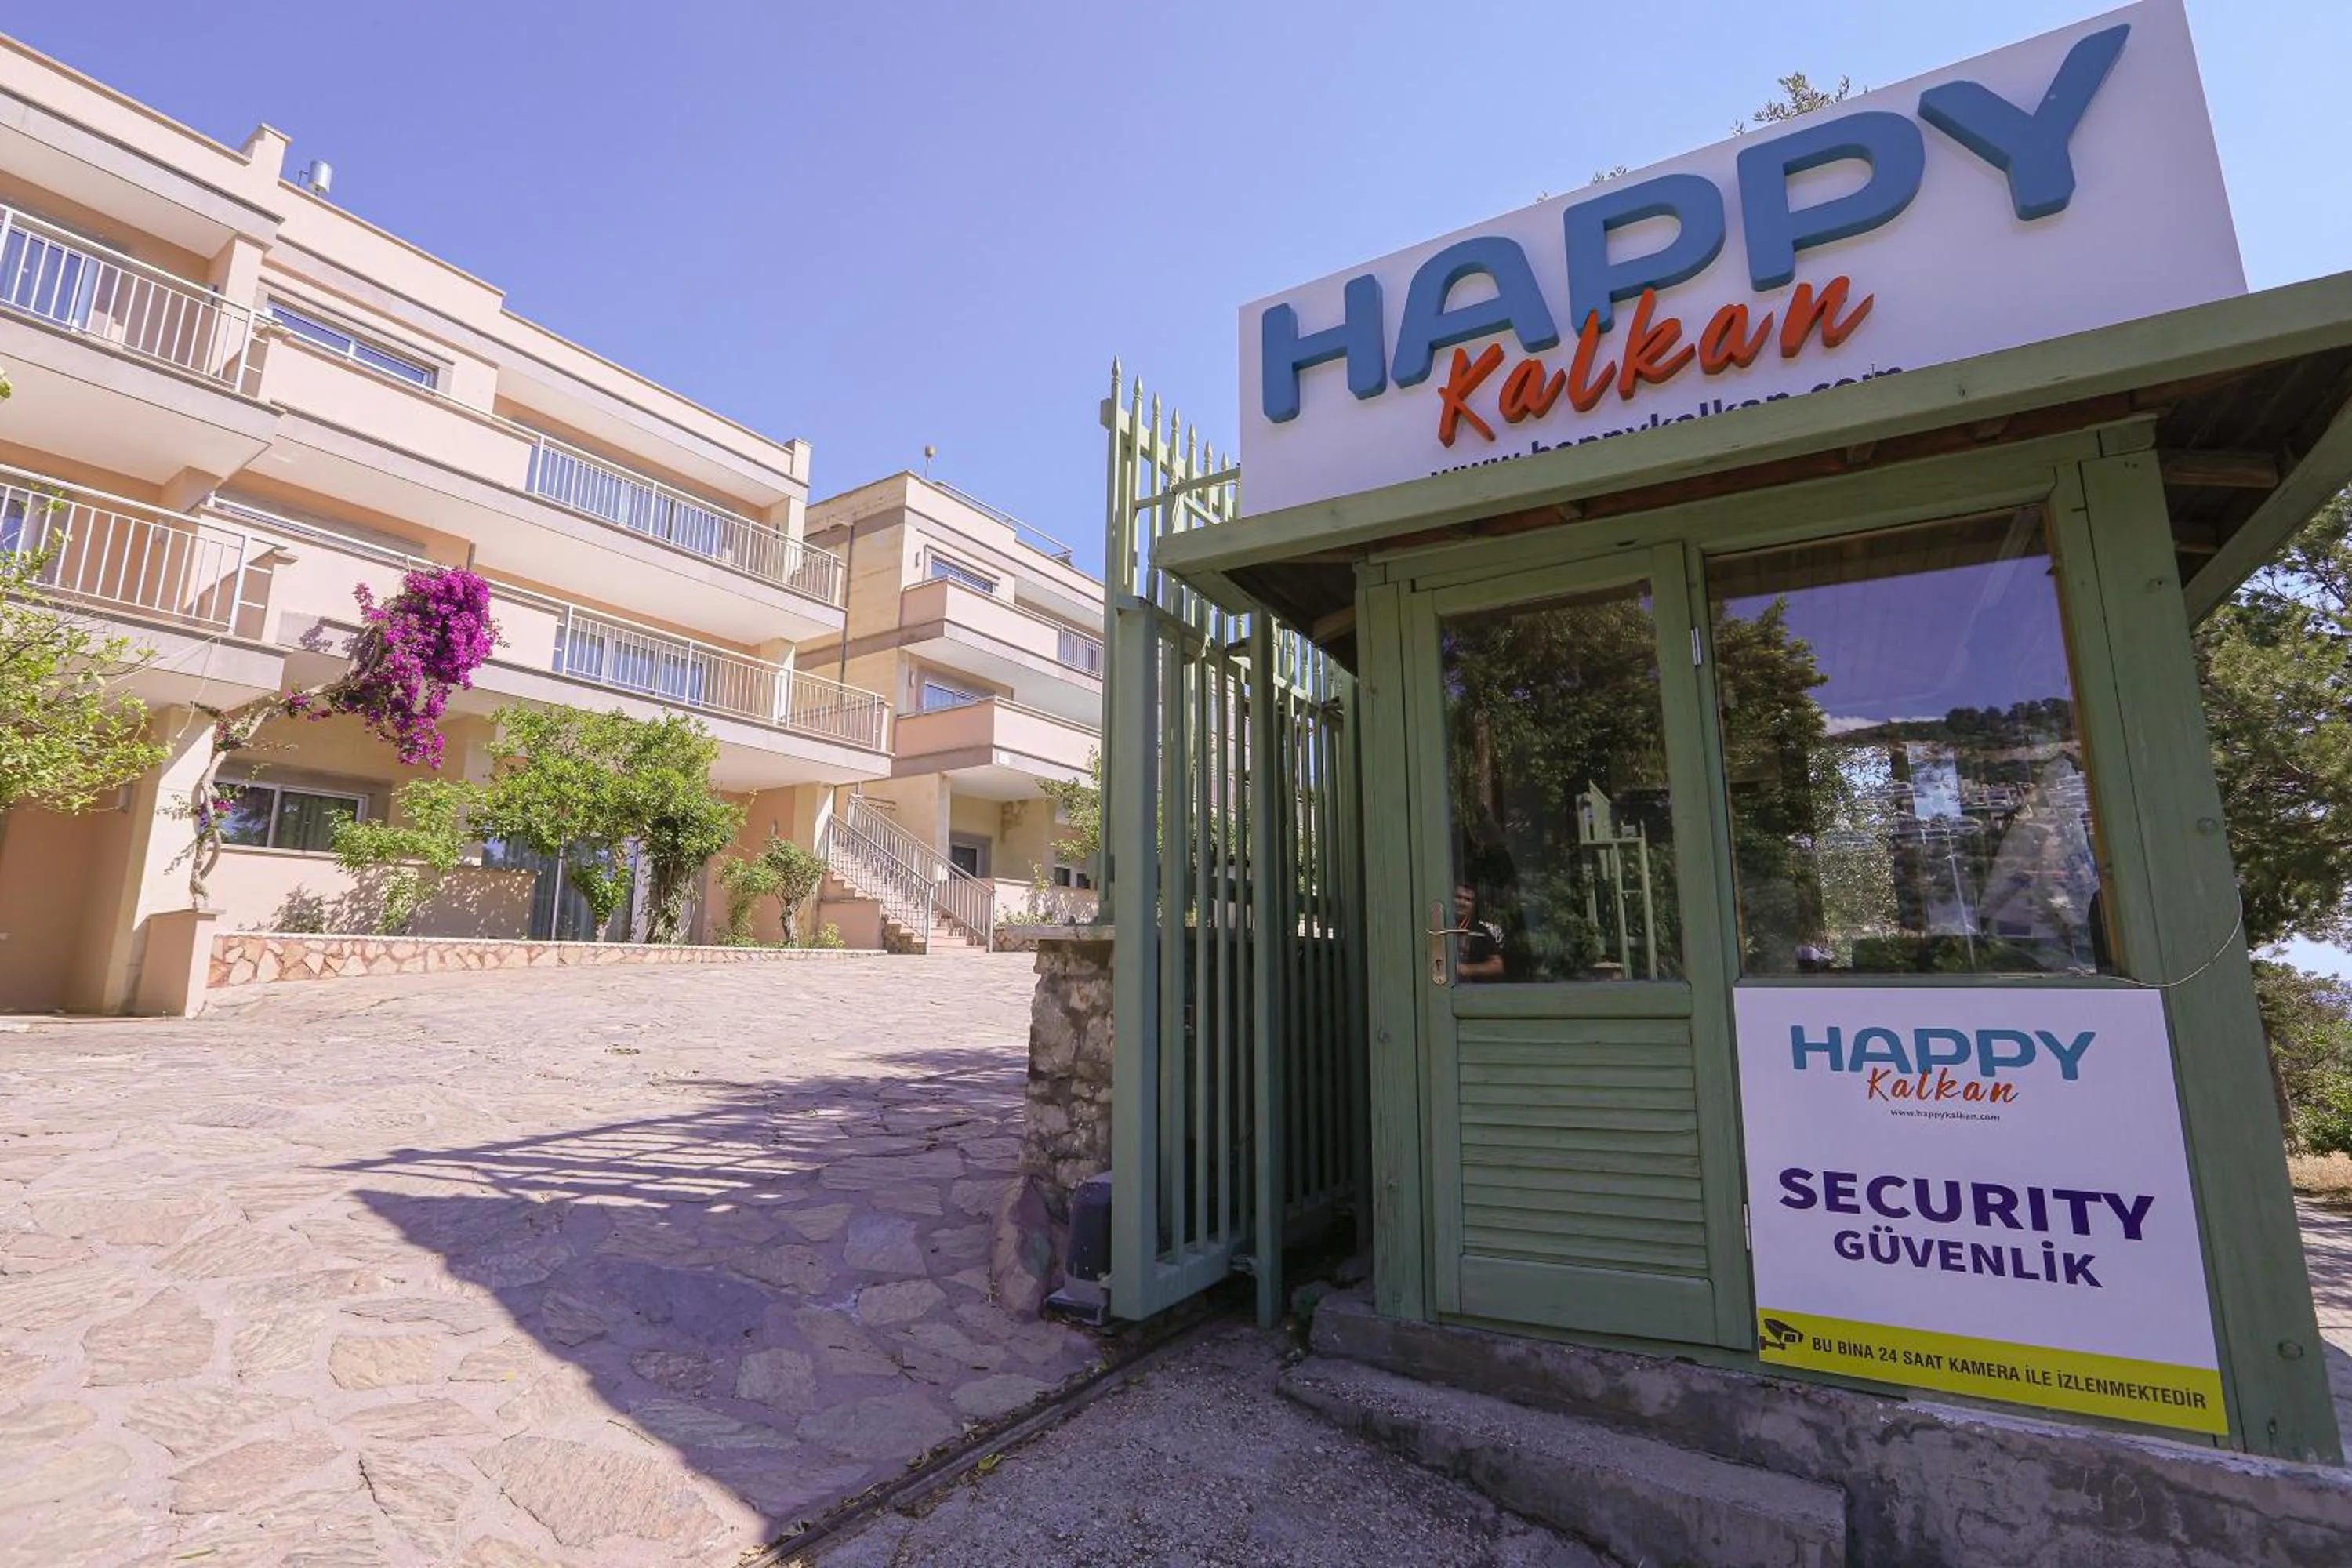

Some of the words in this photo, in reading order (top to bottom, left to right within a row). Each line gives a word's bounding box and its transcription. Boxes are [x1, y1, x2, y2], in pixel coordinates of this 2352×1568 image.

[1261, 23, 2132, 424] HAPPY
[1437, 275, 1875, 449] Kalkan
[1790, 1025, 2096, 1081] HAPPY
[1867, 1067, 2019, 1103] Kalkan
[1890, 1109, 2001, 1122] www.happykalkan.com
[1778, 1167, 2155, 1242] SECURITY
[1833, 1225, 2103, 1289] GÜVENLİK
[1812, 1337, 1832, 1353] BU
[1837, 1338, 1875, 1360] BİNA
[1878, 1346, 1899, 1364] 24
[1903, 1350, 1944, 1370] SAAT
[1948, 1357, 2021, 1383] KAMERA
[2025, 1364, 2053, 1387] İLE
[2056, 1370, 2207, 1410] İZLENMEKTEDİR
